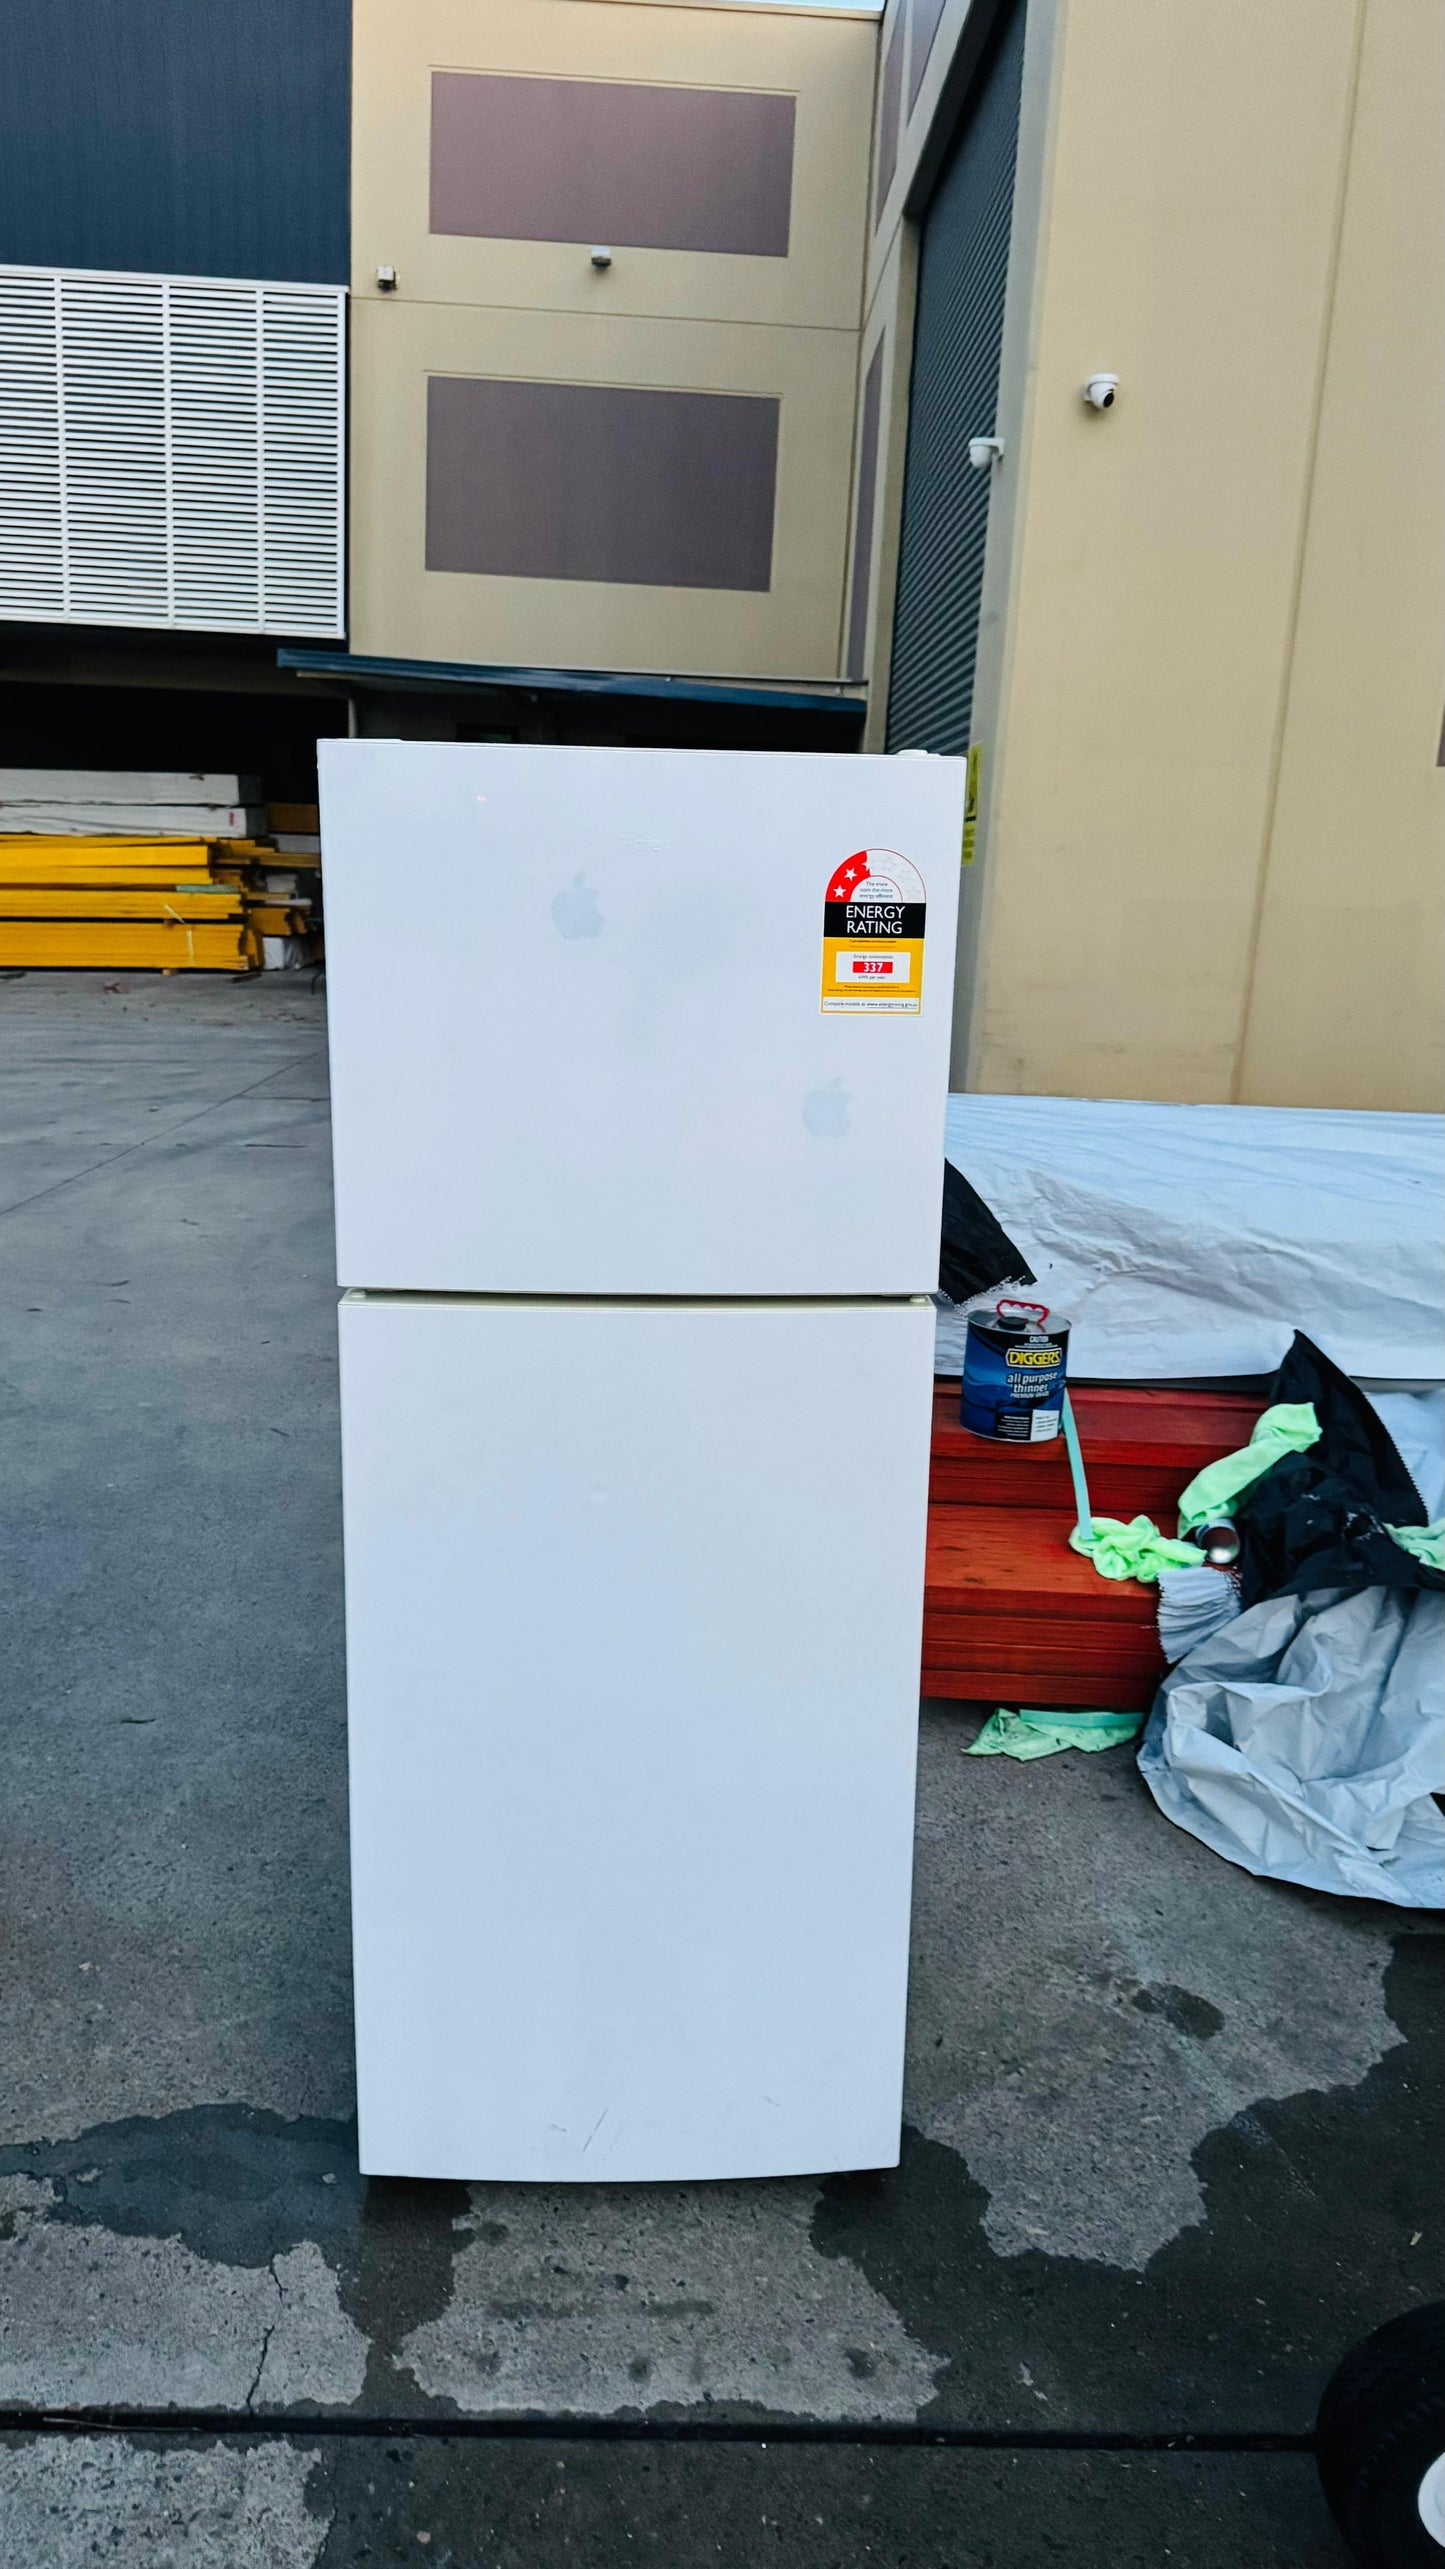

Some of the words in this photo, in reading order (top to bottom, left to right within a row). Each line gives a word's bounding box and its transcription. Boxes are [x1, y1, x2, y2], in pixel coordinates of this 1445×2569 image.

[846, 905, 905, 919] ENERGY
[847, 921, 903, 934] RATING
[863, 962, 883, 973] 337
[1009, 1351, 1060, 1365] DIGGERS
[1007, 1373, 1021, 1383] all
[1022, 1372, 1058, 1385] purpose
[1013, 1383, 1048, 1393] thinner
